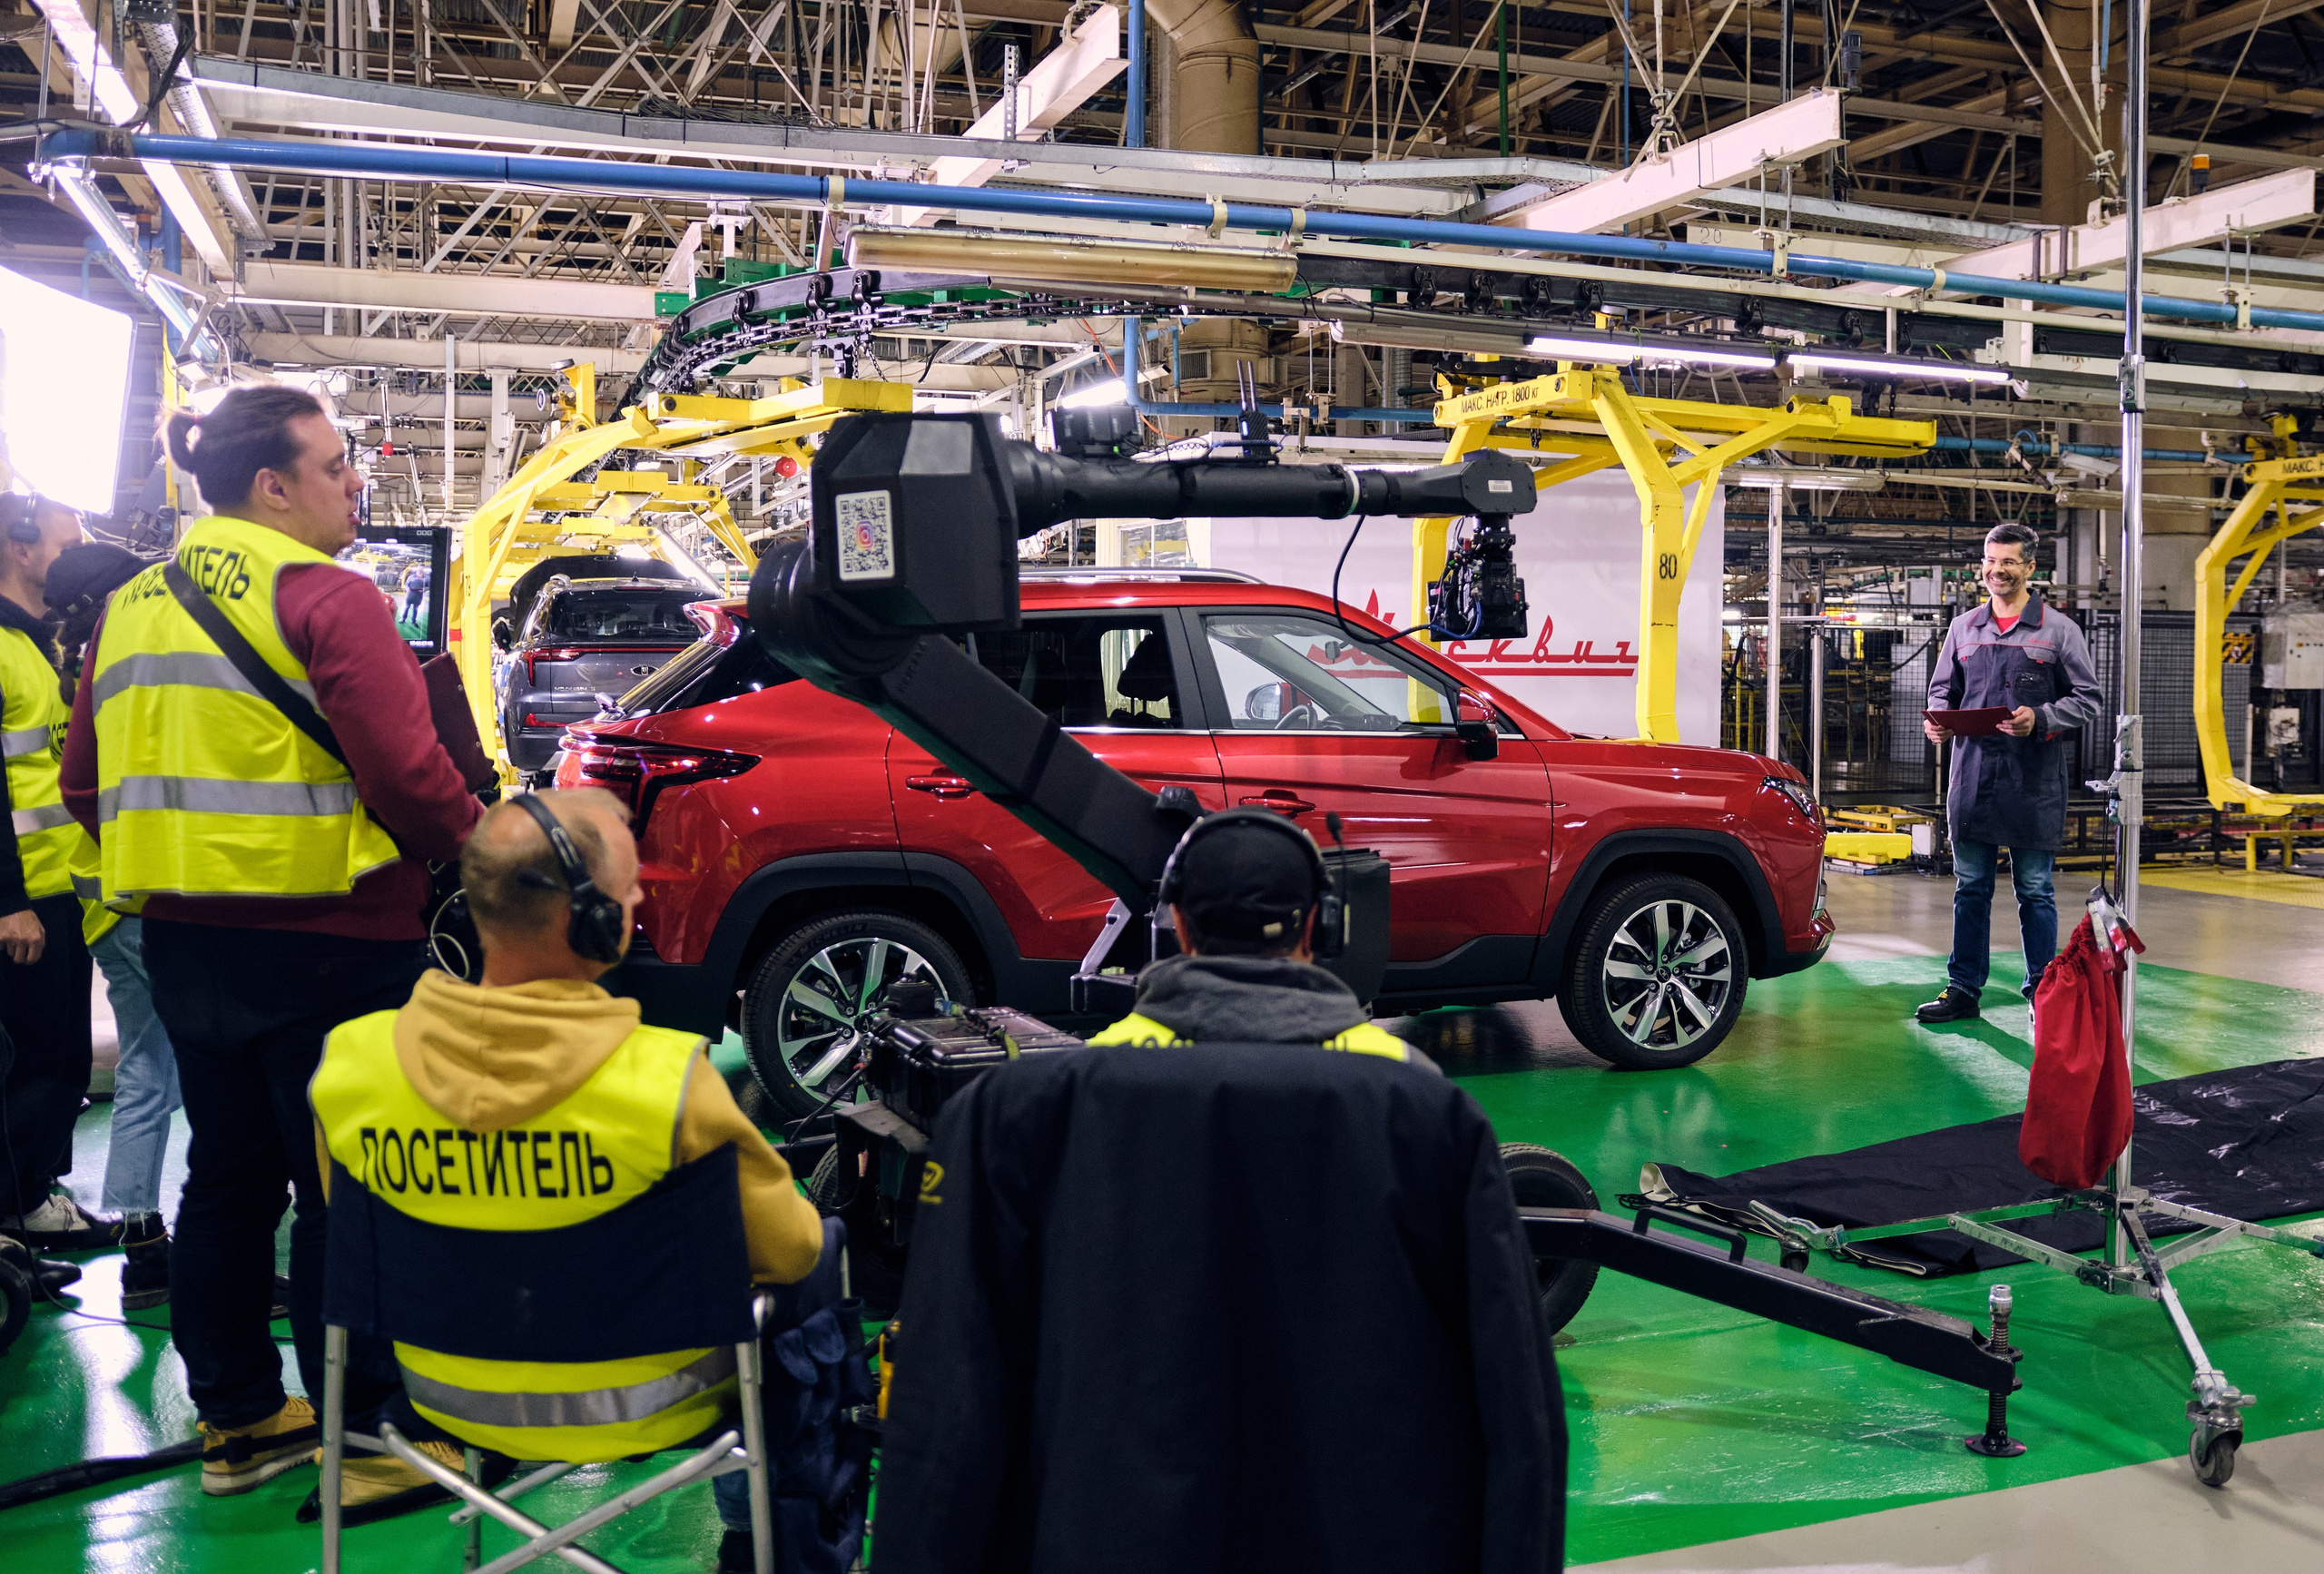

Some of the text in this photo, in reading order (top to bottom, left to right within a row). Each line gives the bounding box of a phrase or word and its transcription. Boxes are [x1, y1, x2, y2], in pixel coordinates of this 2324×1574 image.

[1700, 227, 1721, 244] 20
[1461, 396, 1484, 413] МАКС.
[1512, 386, 1531, 403] 1800
[2281, 459, 2317, 474] МАКС.
[1659, 553, 1678, 580] 80
[360, 1127, 615, 1198] ПОСЕТИТЕЛЬ
